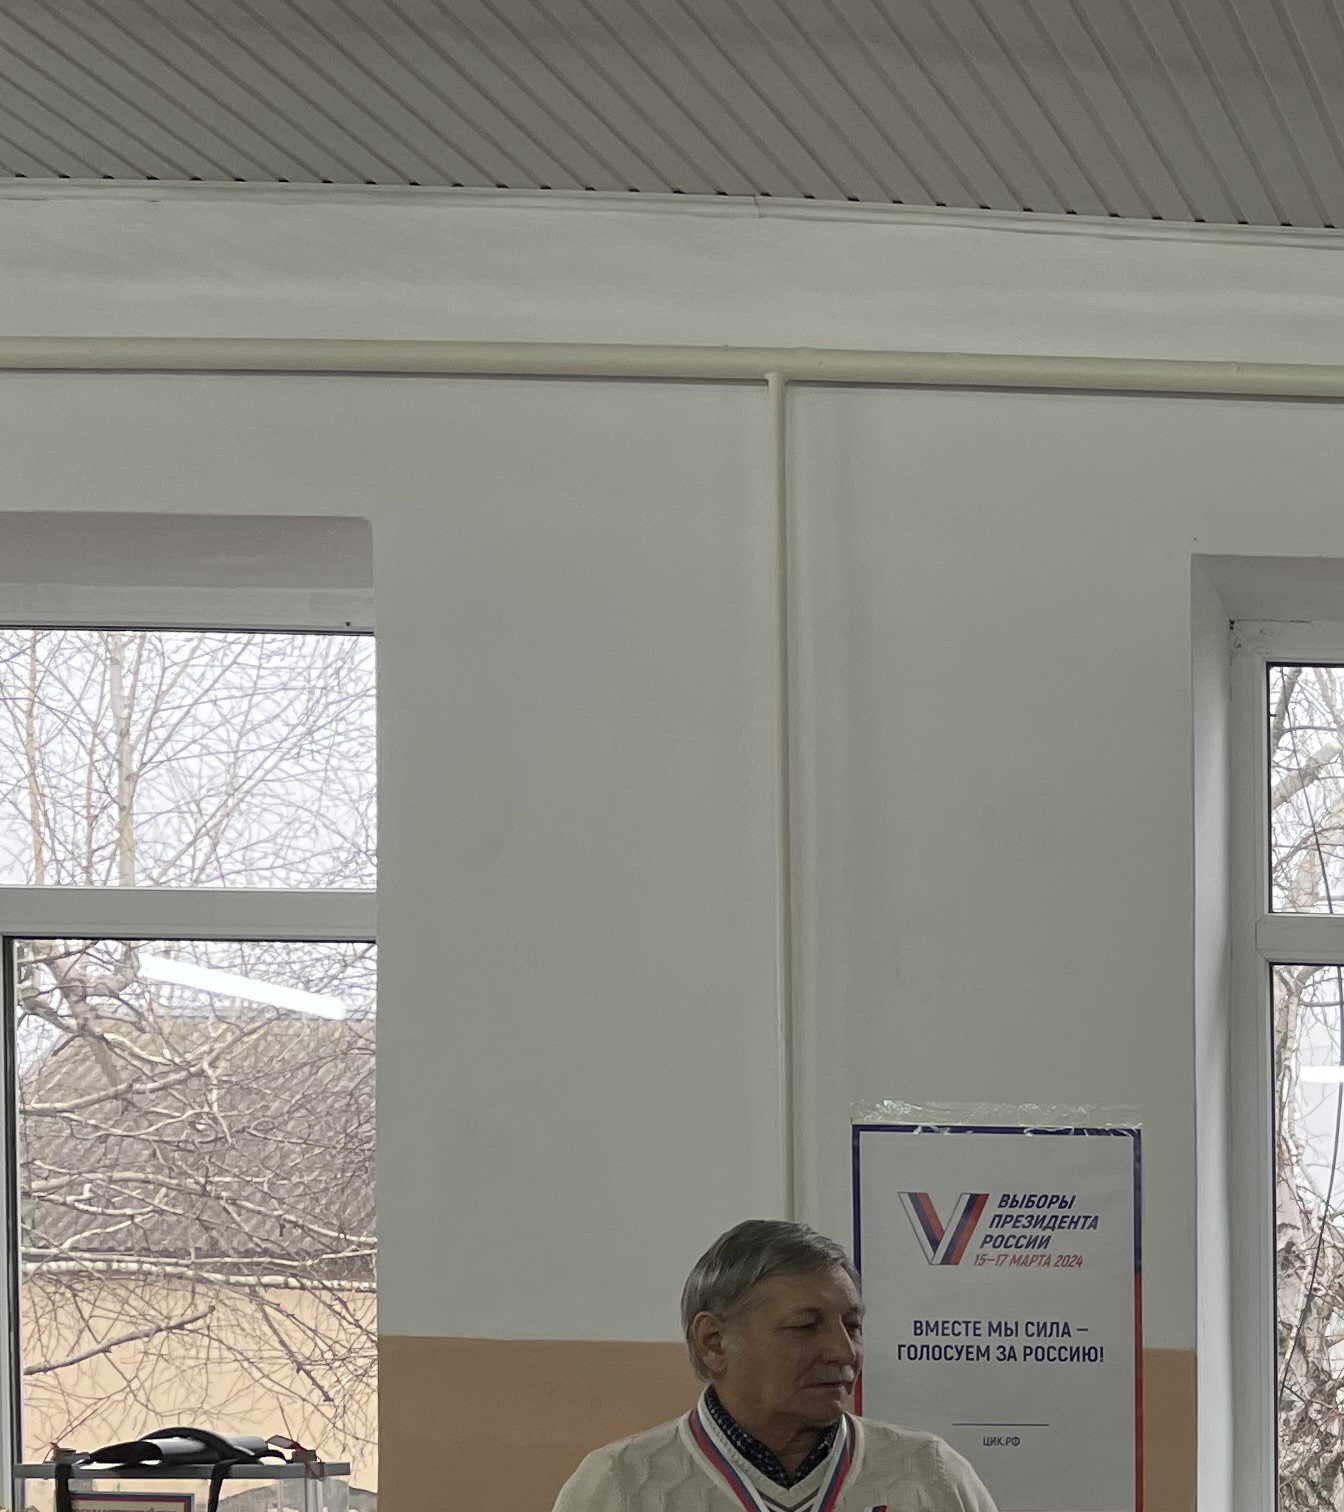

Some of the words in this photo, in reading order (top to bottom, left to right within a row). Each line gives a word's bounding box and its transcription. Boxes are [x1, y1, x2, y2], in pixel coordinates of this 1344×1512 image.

[998, 1194, 1076, 1209] ВЫБОРЫ
[988, 1214, 1099, 1232] ПРЕЗИДЕНТА
[980, 1235, 1051, 1250] РОССИИ
[1009, 1255, 1051, 1268] МАРТА
[1053, 1255, 1083, 1268] 2024
[913, 1321, 982, 1337] ВМЕСТЕ
[988, 1321, 1019, 1338] МЫ
[1025, 1322, 1071, 1338] СИЛА
[898, 1344, 990, 1362] ГОЛОСУЕМ
[996, 1345, 1017, 1362] ЗА
[1023, 1345, 1104, 1363] РОССИЮ!
[983, 1436, 1020, 1448] ЦИК.РФ
